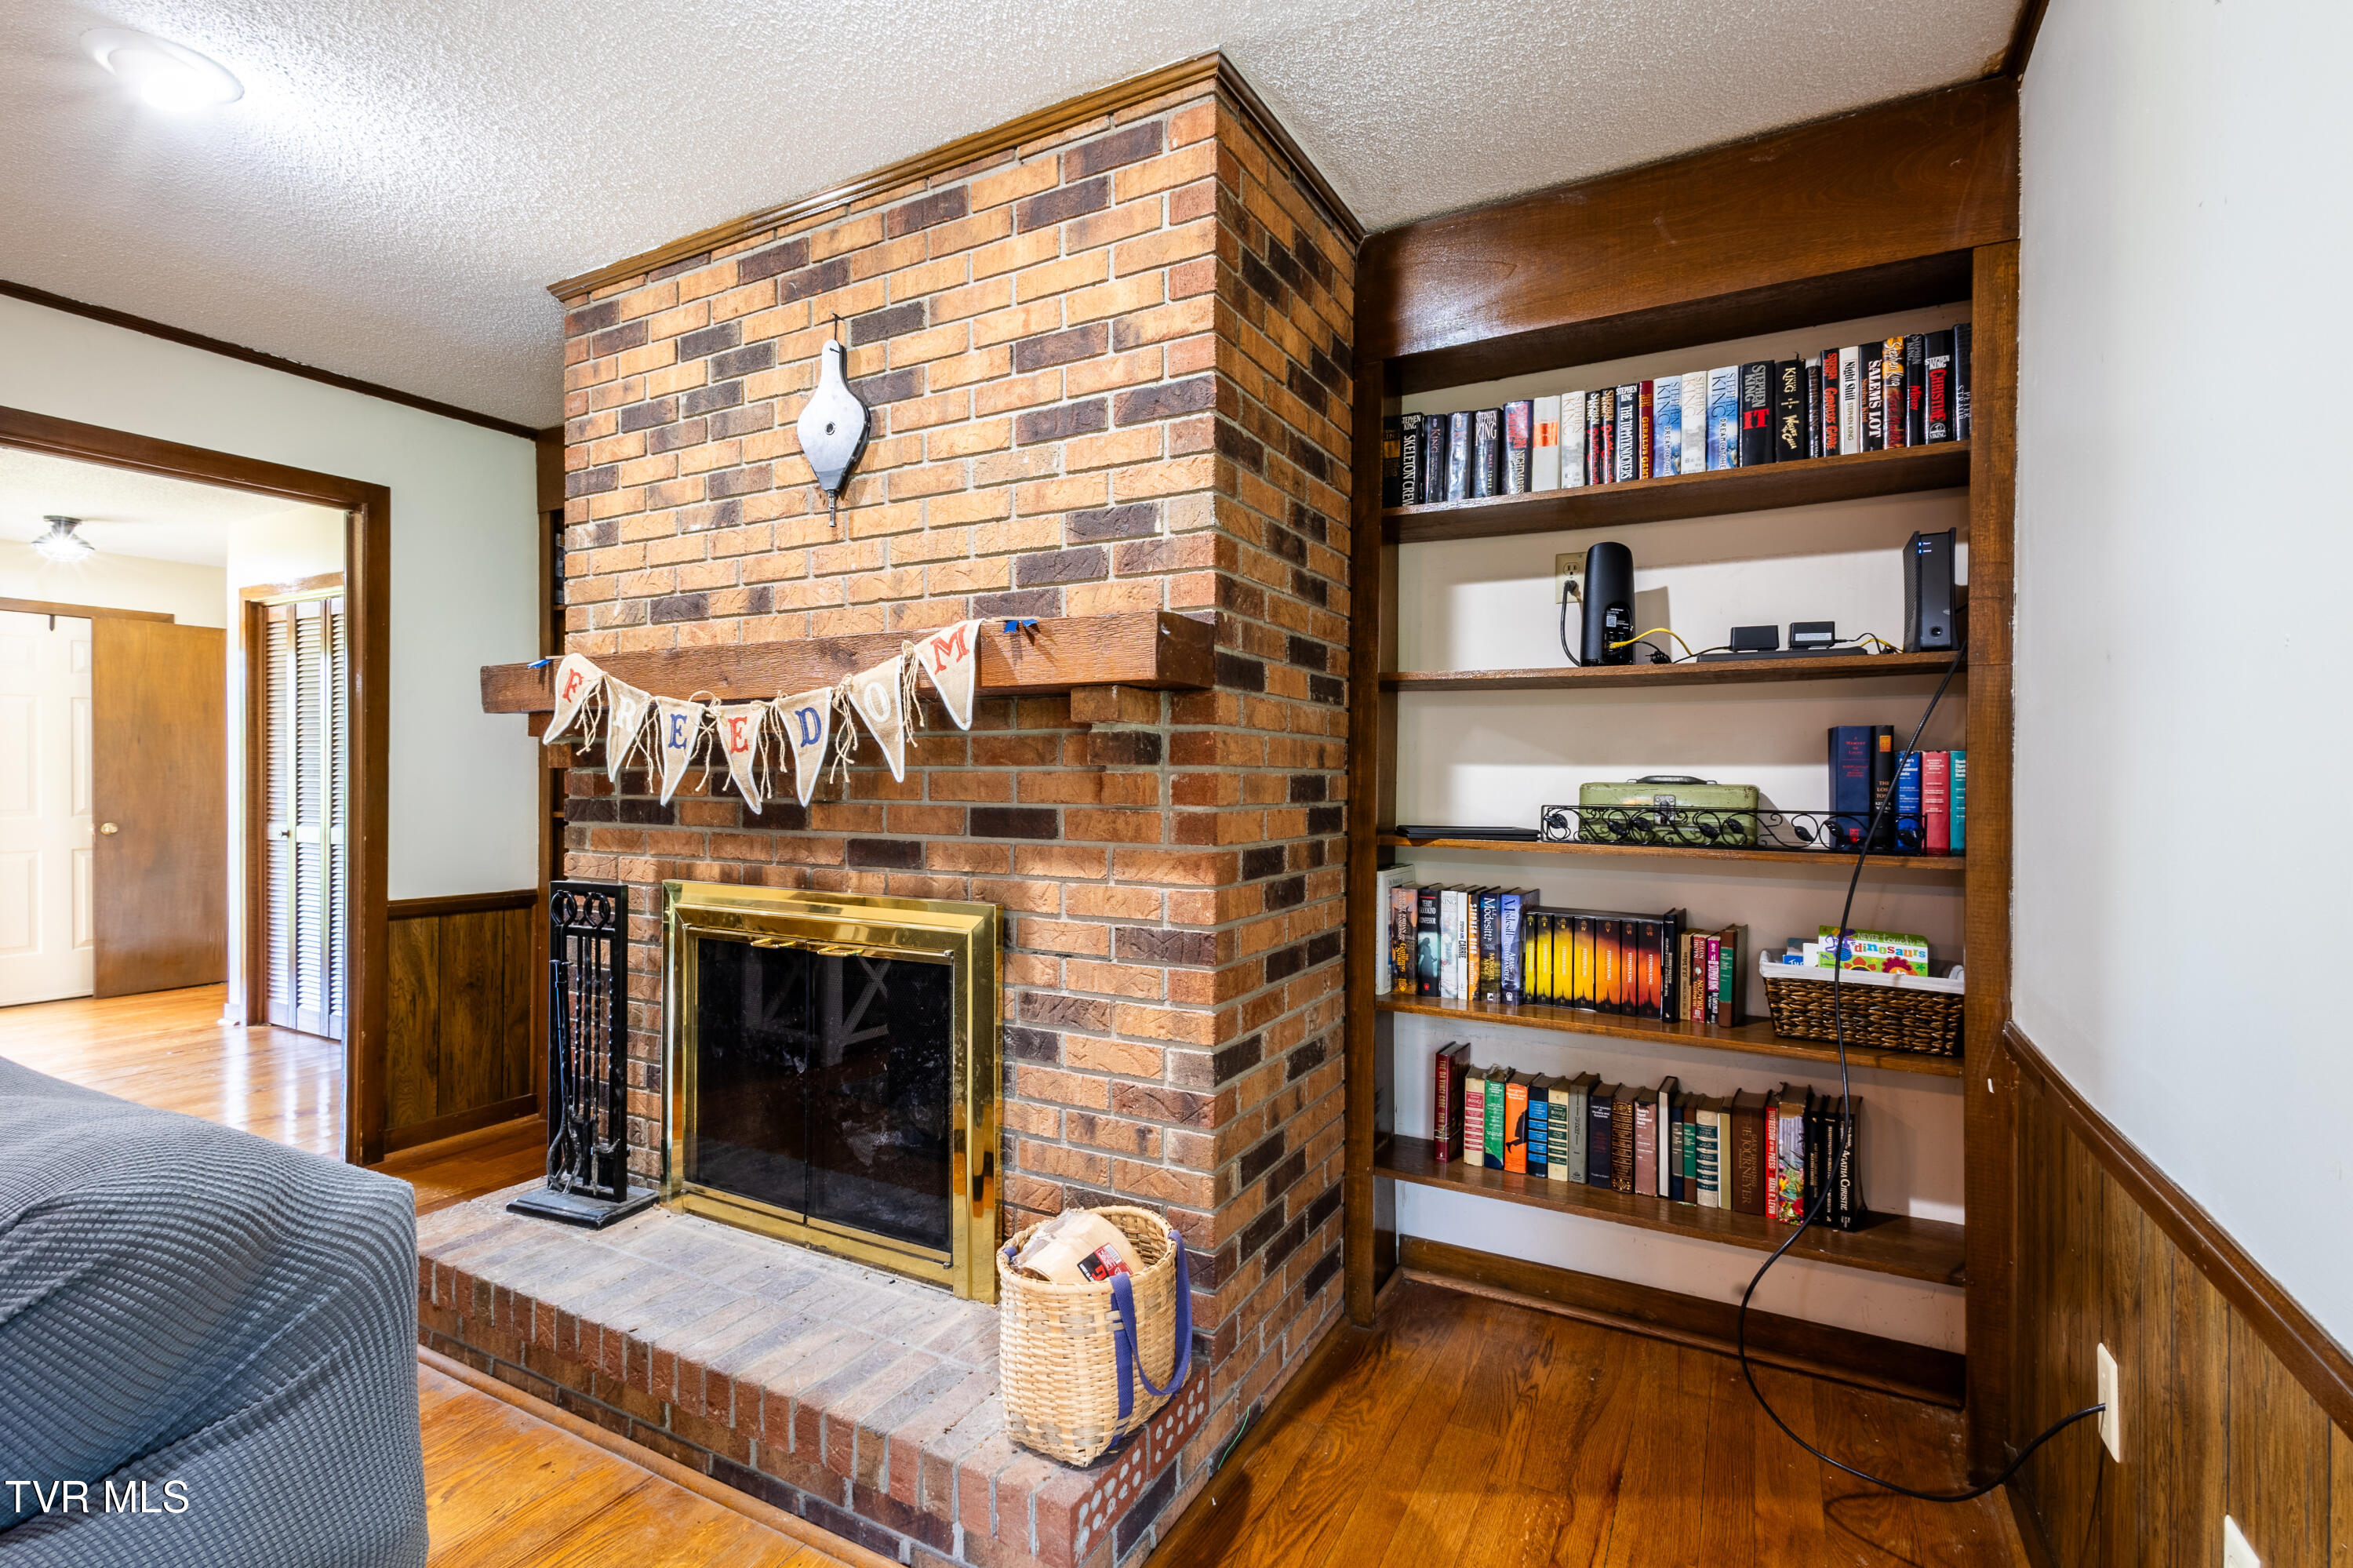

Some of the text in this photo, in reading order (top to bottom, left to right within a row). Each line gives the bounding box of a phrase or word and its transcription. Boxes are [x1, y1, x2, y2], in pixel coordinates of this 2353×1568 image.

[1883, 342, 1904, 387] Stephen King
[1912, 336, 1922, 365] STEPHEN
[1924, 355, 1951, 366] STEPHEN
[1782, 367, 1795, 393] KING
[1827, 352, 1838, 380] STEPHEN
[1844, 361, 1857, 401] Night Shift
[1929, 362, 1947, 370] KING
[1616, 384, 1638, 395] STEPHEN
[1620, 392, 1633, 402] KING
[1682, 378, 1697, 418] KING
[1696, 377, 1707, 416] STEPHEN
[1711, 375, 1726, 418] KING
[1726, 372, 1737, 417] STEPHEN
[1744, 374, 1755, 402] KING
[1751, 364, 1766, 408] STEPHEN
[1810, 368, 1820, 407] STEPHEN
[1929, 369, 1947, 423] CHRISTINE
[1475, 410, 1497, 424] STEPHEN
[1562, 398, 1576, 435] KING
[1573, 395, 1584, 434] STEPHEN
[1587, 400, 1595, 421] KING
[1590, 393, 1600, 424] STEPHEN
[1604, 389, 1614, 421] STEPHEN
[1657, 384, 1671, 426] KING
[1670, 381, 1680, 425] STEPHEN
[1888, 391, 1903, 413] Rose
[1742, 408, 1769, 430] IT
[1824, 387, 1838, 450] GERALD'S GAME
[1868, 410, 1882, 438] LOT
[1430, 427, 1441, 454] KING
[1475, 422, 1497, 446] KING
[1620, 404, 1633, 479] THE TOMMYKNOCKERS
[1718, 418, 1727, 469] DREAMCATCHE
[1402, 434, 1416, 480] SKELETON
[562, 624, 970, 754] FREEDOM
[1469, 904, 1478, 934] STEPHEN
[1458, 940, 1467, 959] CARRIE
[1469, 937, 1478, 955] KING
[1854, 943, 1926, 959] dinosaurs
[1882, 934, 1914, 946] touch
[1438, 1071, 1446, 1079] DA
[1741, 1140, 1751, 1204] JOURNEYER
[1841, 1149, 1850, 1178] AGATHA
[1840, 1178, 1851, 1210] CHRISTIE
